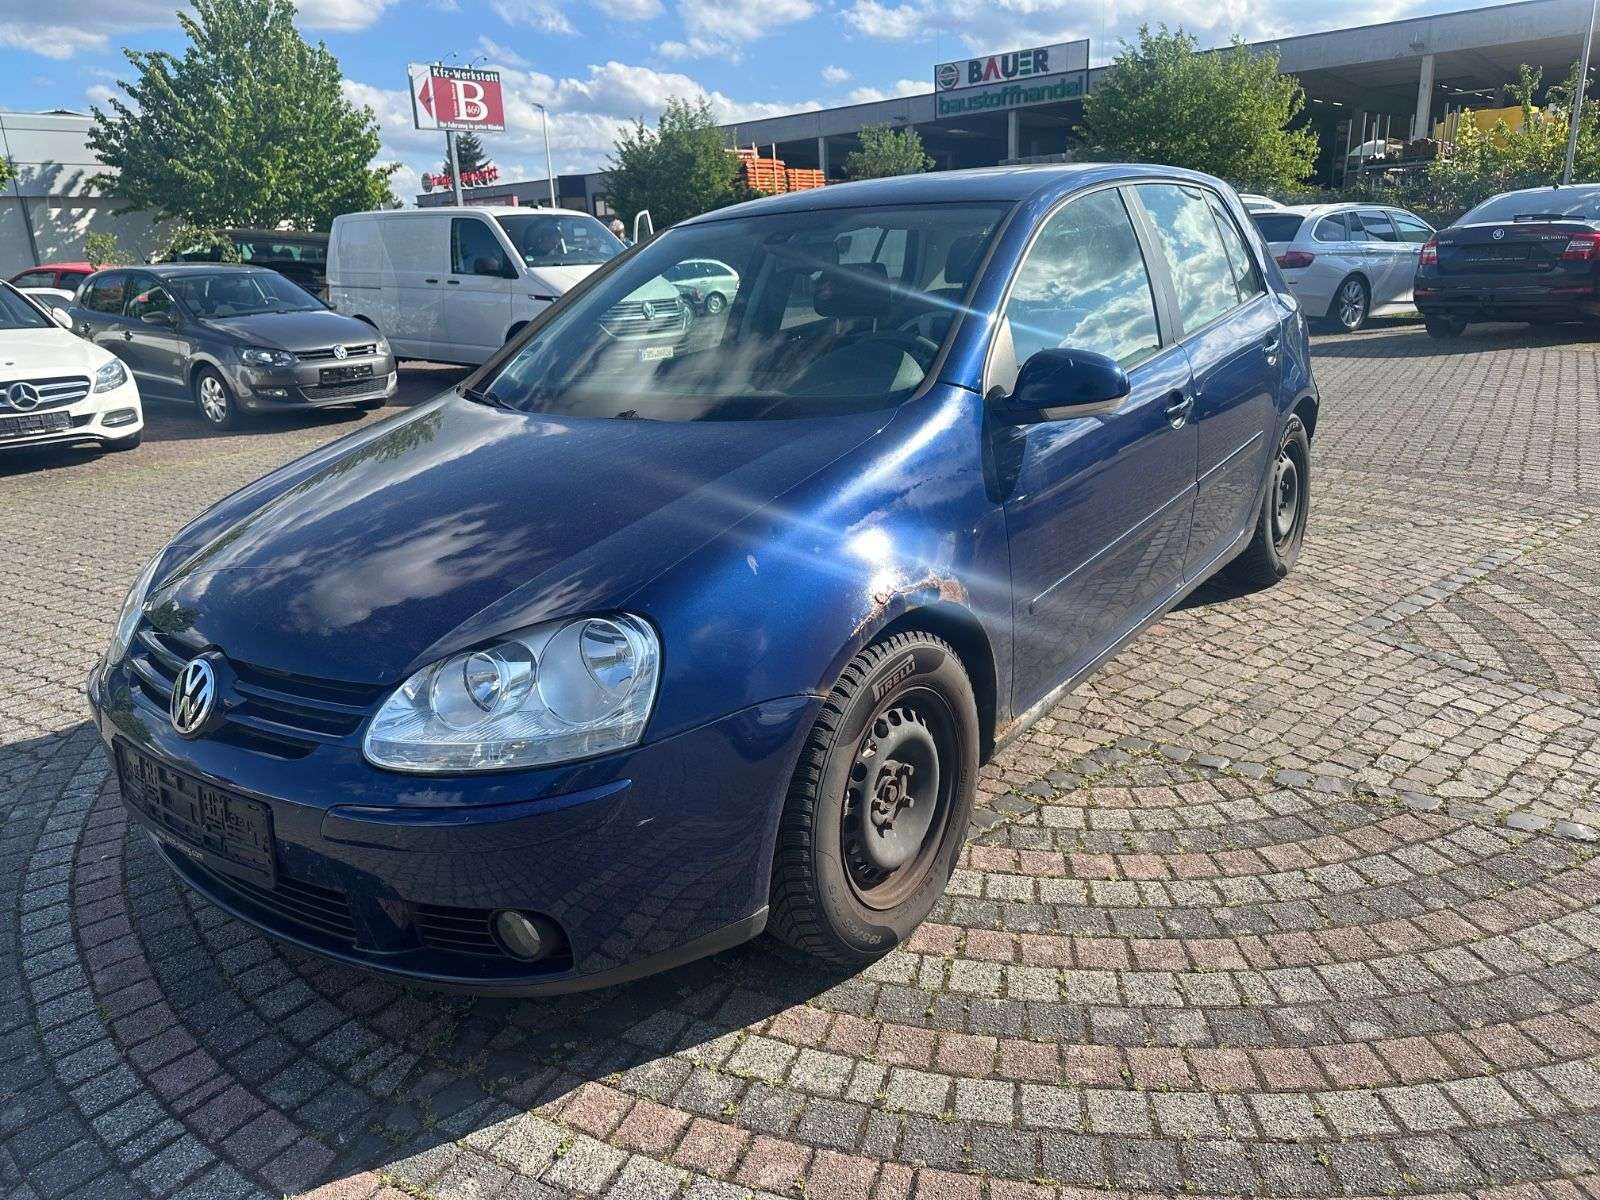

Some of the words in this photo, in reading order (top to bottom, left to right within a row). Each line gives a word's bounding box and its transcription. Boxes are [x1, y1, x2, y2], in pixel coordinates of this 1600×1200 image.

[432, 67, 499, 83] Kfz-Werkstatt
[968, 49, 1050, 84] BAUER
[450, 79, 489, 121] B
[938, 75, 1084, 114] baustoffhandel
[871, 653, 916, 701] PIRELLI
